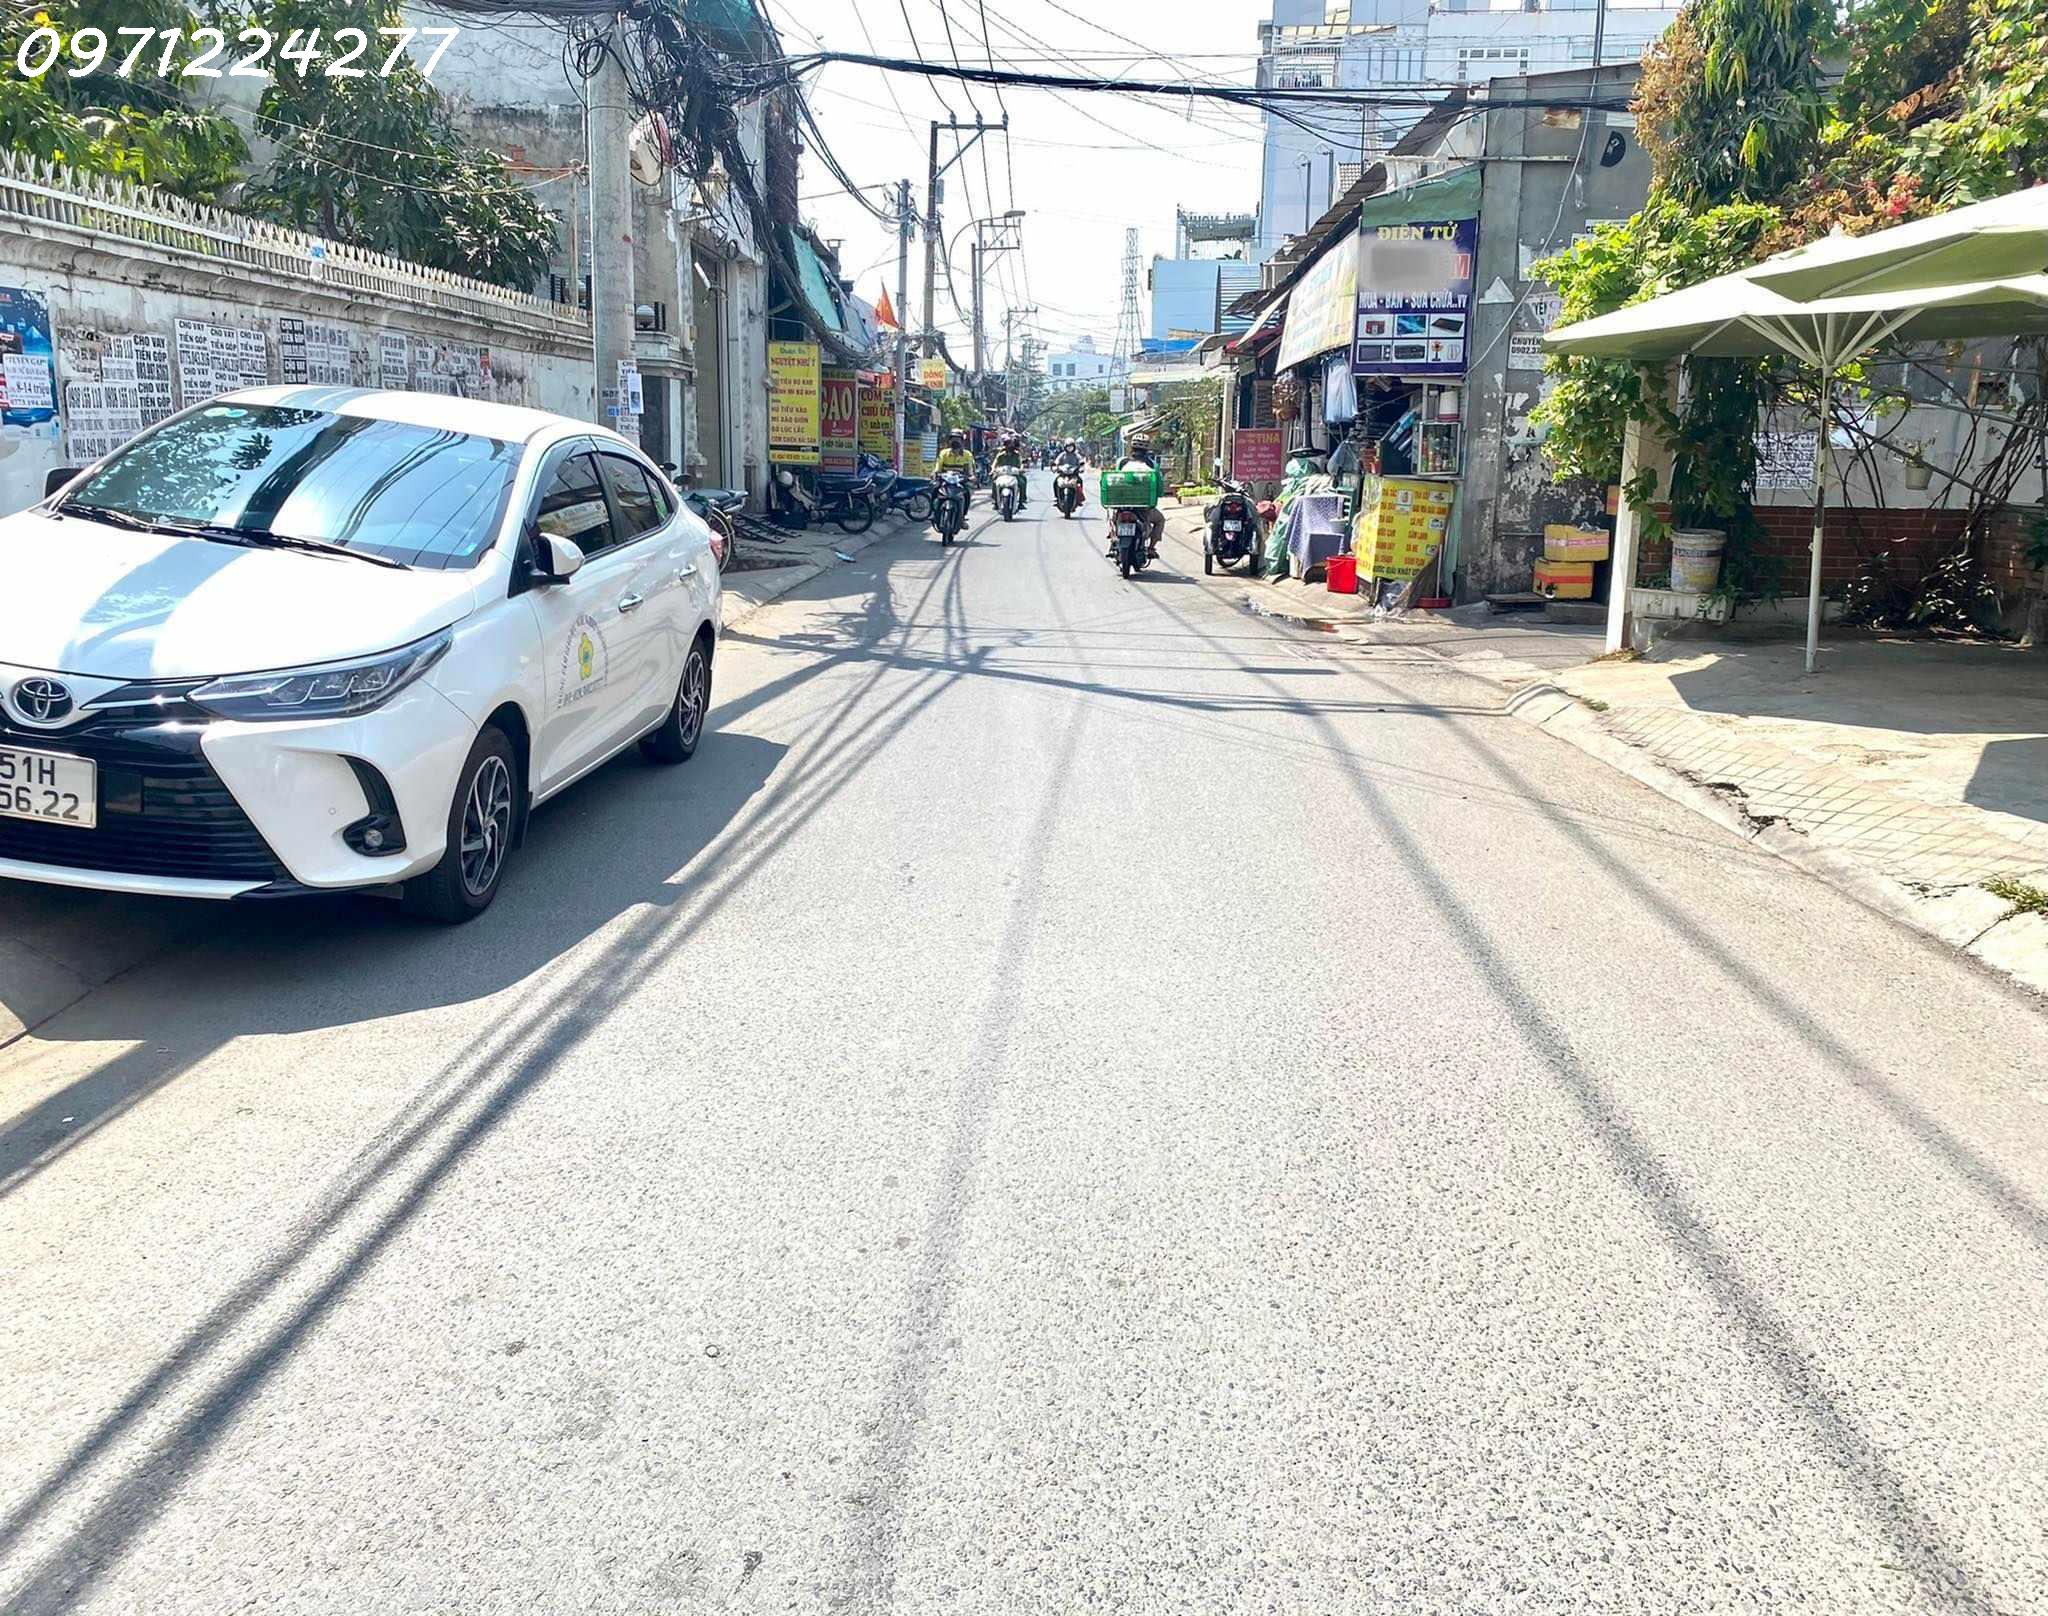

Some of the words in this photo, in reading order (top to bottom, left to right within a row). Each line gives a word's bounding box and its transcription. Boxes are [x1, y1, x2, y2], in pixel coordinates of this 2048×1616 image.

[1430, 221, 1458, 241] TỬ
[133, 335, 150, 346] CHO
[151, 337, 166, 348] VAY
[138, 382, 153, 393] CHO
[156, 383, 170, 393] VAY
